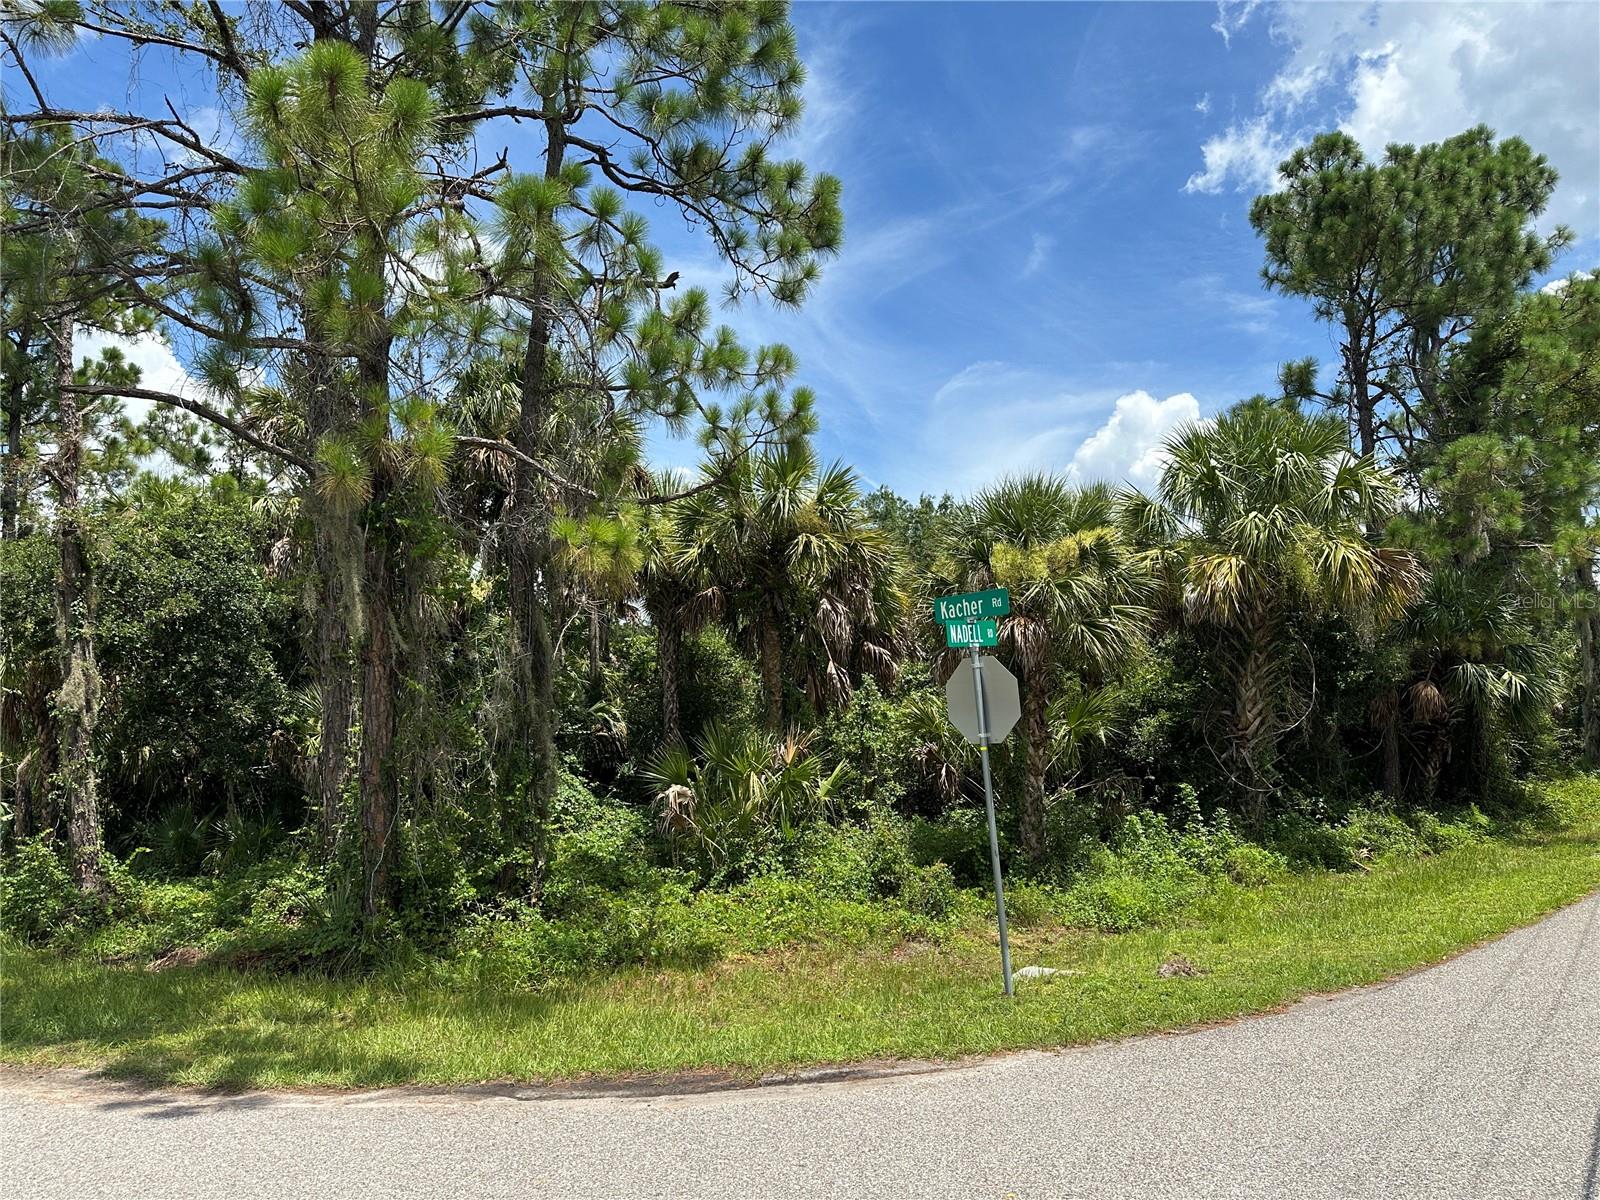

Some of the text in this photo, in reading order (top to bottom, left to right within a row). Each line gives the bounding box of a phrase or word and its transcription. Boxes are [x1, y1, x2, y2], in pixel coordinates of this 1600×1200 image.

[940, 597, 1002, 619] Kacher Rd
[949, 624, 984, 643] NADELL
